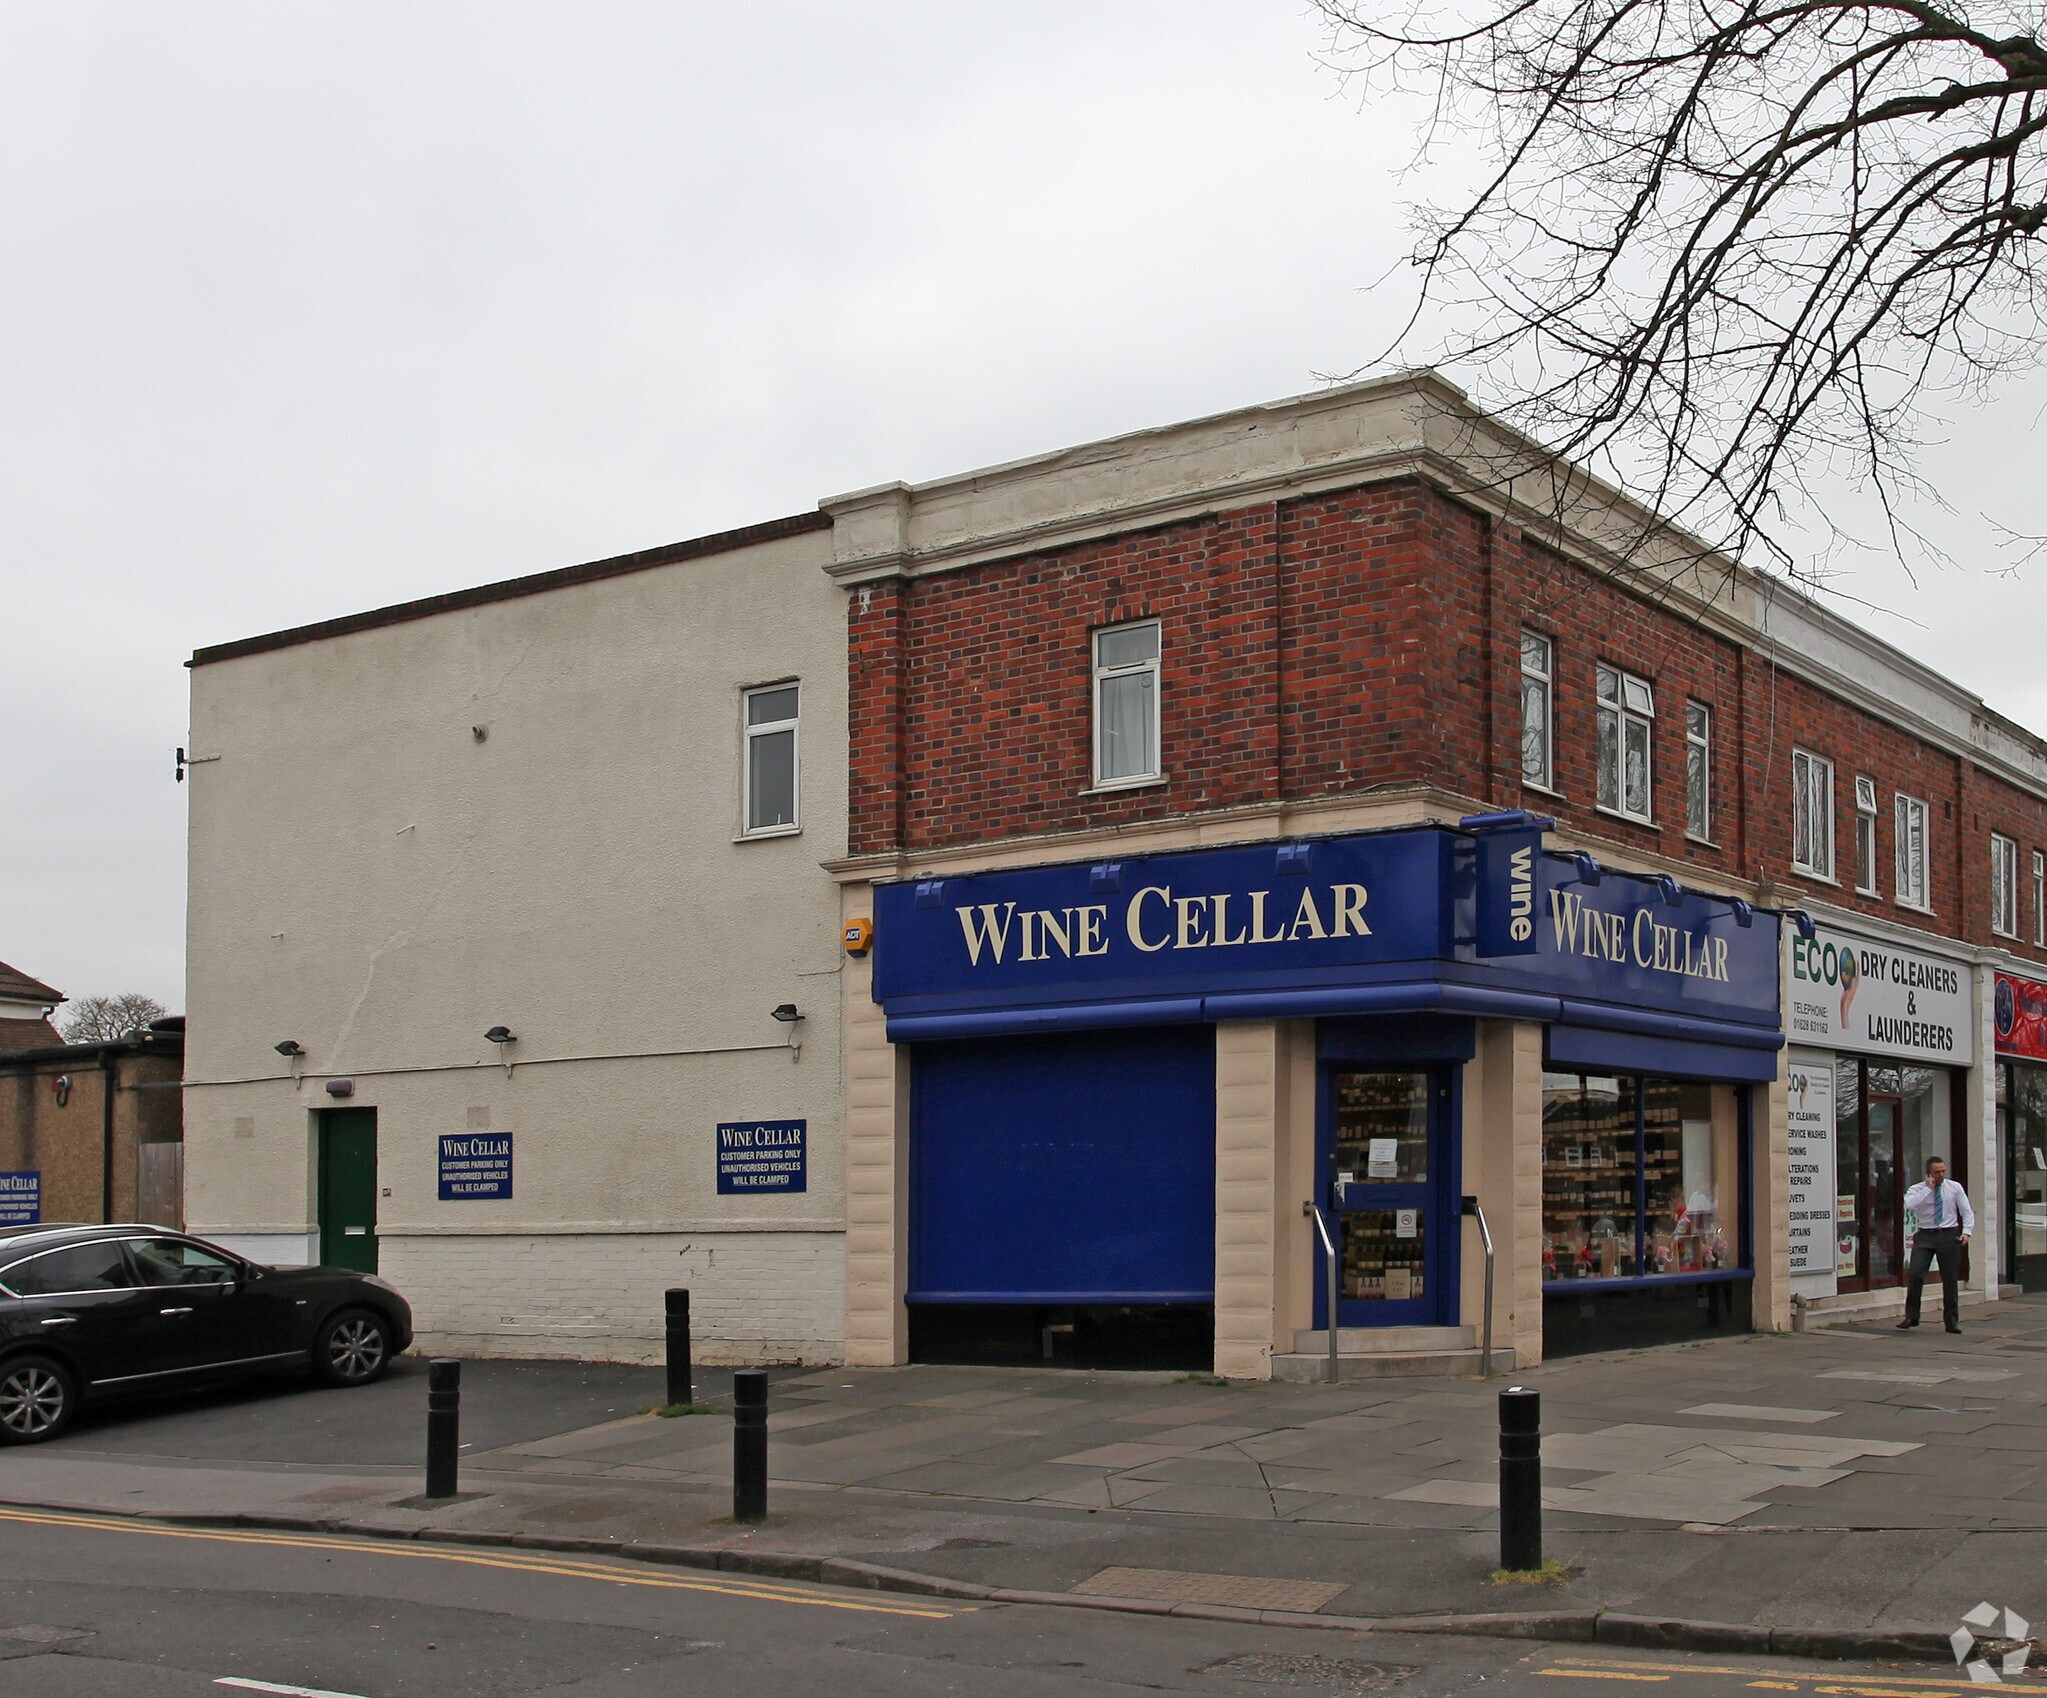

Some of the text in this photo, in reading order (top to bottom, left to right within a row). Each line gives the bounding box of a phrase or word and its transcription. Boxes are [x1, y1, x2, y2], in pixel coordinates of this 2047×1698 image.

[955, 883, 1373, 967] WINE CELLAR
[1549, 888, 1730, 982] WINE CELLAR
[1793, 934, 1838, 986] ECO
[1860, 950, 1958, 994] DRY CLEANERS
[1907, 990, 1917, 1015] &
[1793, 1001, 1829, 1018] TELEPHONE:
[1868, 1014, 1953, 1051] LAUNDERERS
[1795, 1112, 1821, 1122] CLEANING
[721, 1127, 802, 1147] WINE CELLAR
[1788, 1129, 1827, 1139] ERVICE WASHES
[443, 1138, 509, 1156] WINE CELLAR
[721, 1150, 801, 1161] CUSTOMER PARKING ONLY
[721, 1162, 801, 1173] UNAUTHORISED VEHICLES
[1788, 1164, 1819, 1173] LTERATIONS
[0, 1176, 38, 1190] INE CELLAR
[733, 1175, 789, 1185] WILL BE CLAMPED
[1790, 1177, 1812, 1185] REPAIRS
[1789, 1210, 1831, 1220] EDDING DRESSES
[1789, 1245, 1808, 1254] EATHER
[1790, 1258, 1807, 1267] SUEDE
